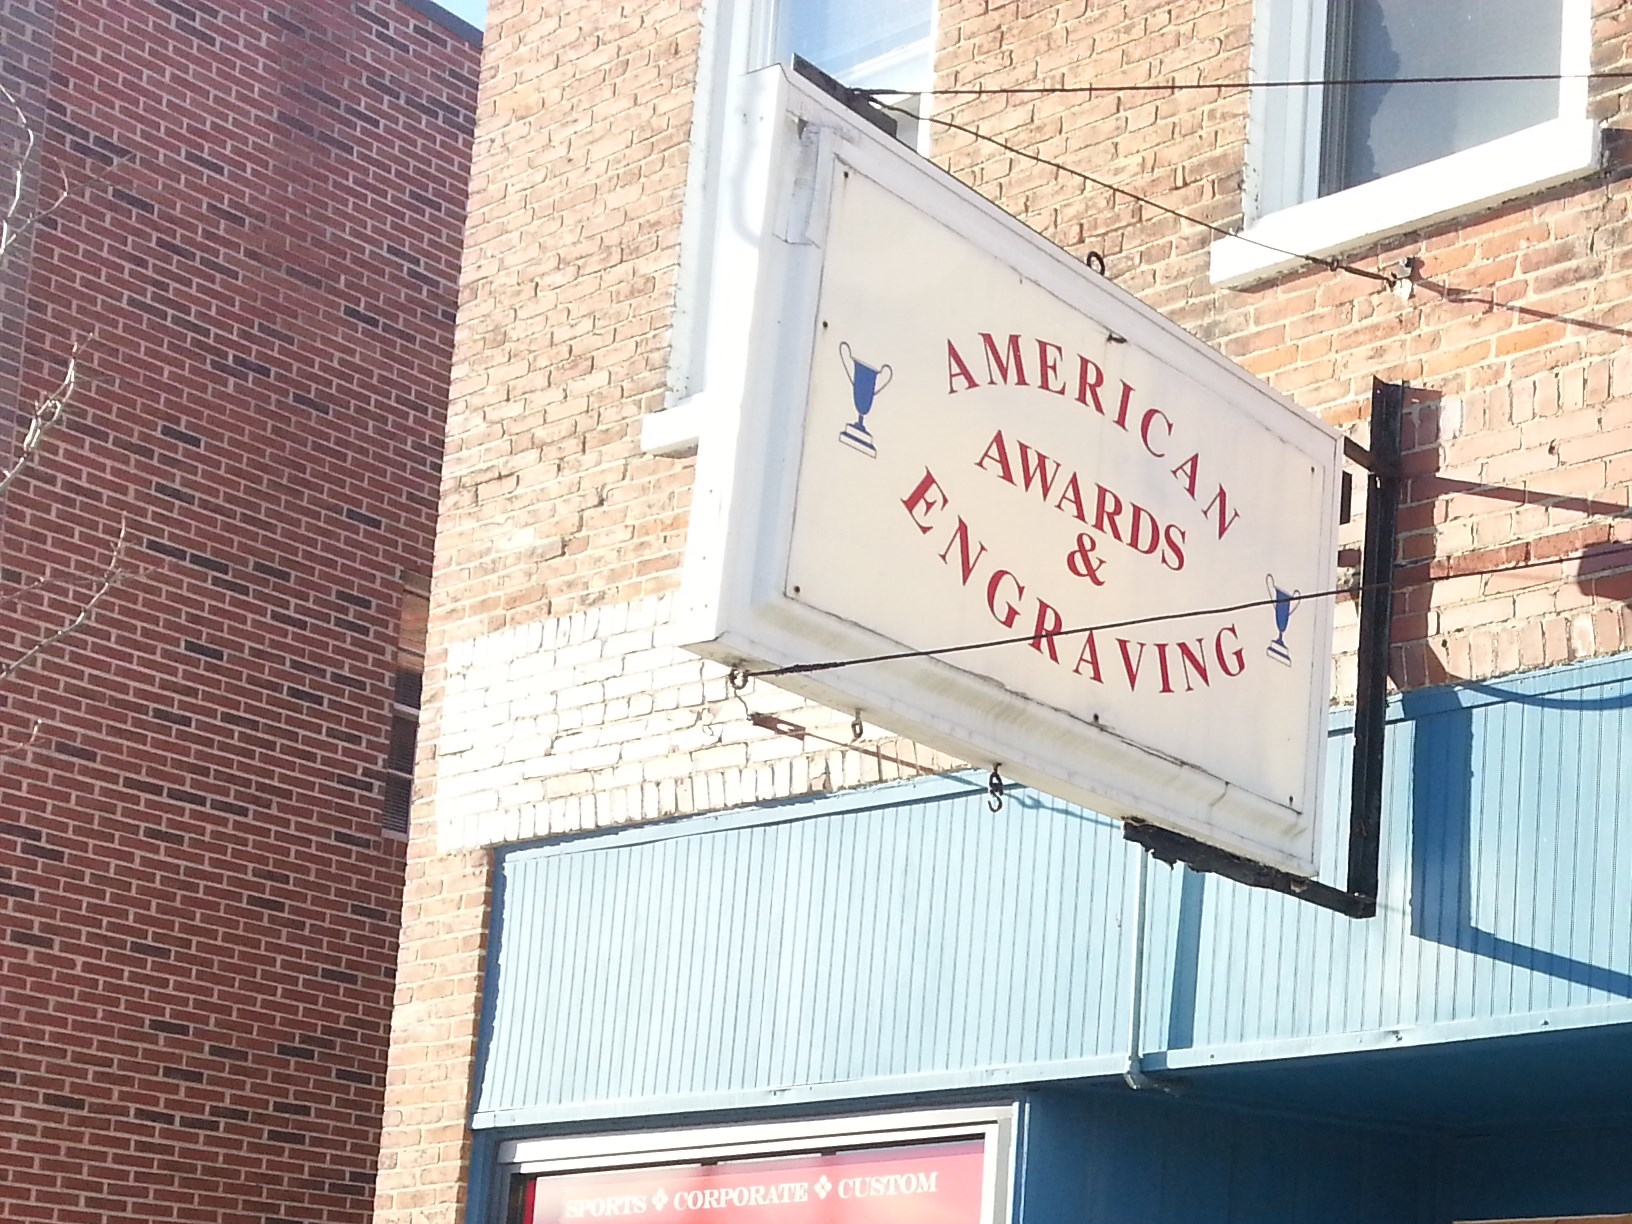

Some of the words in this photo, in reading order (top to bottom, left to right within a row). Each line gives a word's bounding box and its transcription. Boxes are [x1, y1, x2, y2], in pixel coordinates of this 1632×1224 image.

[946, 332, 1241, 540] AMERICAN
[974, 429, 1187, 571] AWARDS
[900, 466, 1247, 694] ENGRAVING
[1066, 532, 1106, 586] &
[565, 1195, 646, 1219] SPORTS
[673, 1182, 809, 1211] CORPORATE
[838, 1171, 938, 1199] CUSTOM
